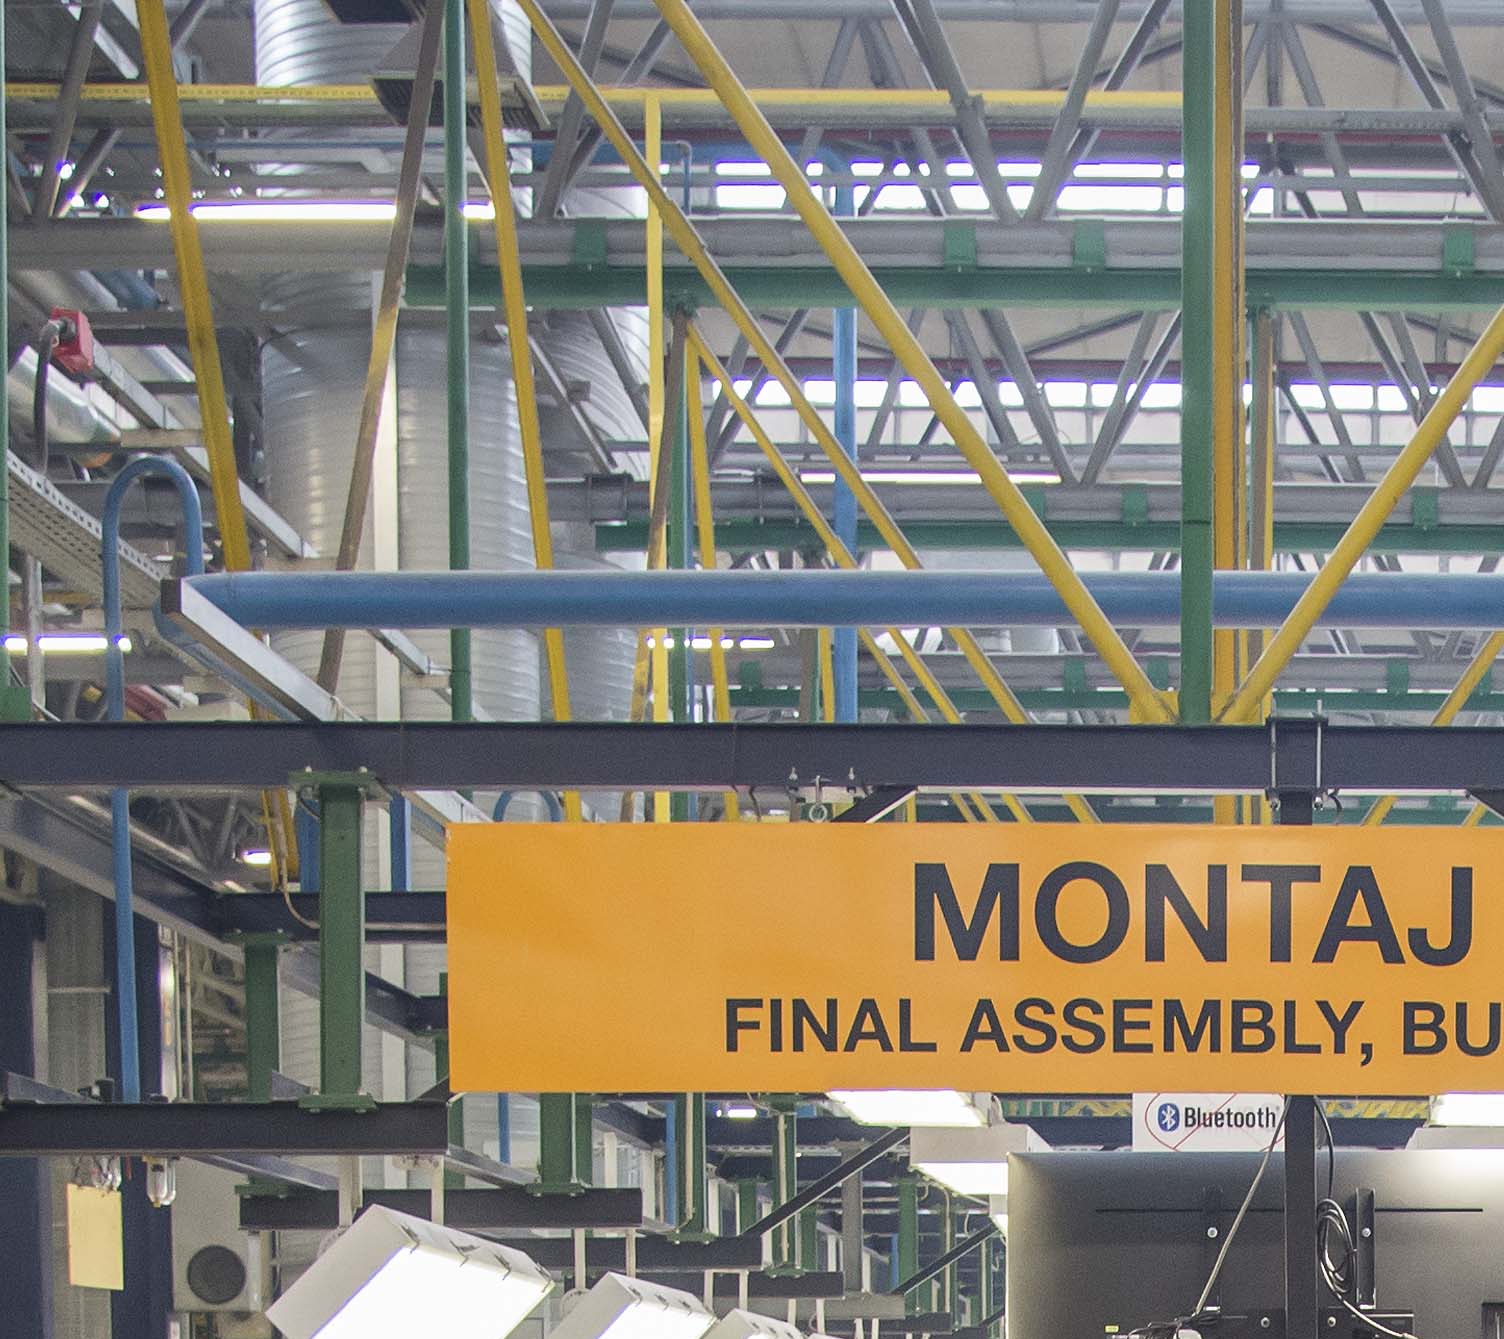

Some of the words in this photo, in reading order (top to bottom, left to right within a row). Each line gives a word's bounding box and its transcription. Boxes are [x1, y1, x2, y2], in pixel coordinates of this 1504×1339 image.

[914, 860, 1474, 967] MONTAJ
[725, 998, 937, 1053] FINAL
[959, 997, 1373, 1067] ASSEMBLY,
[1184, 1107, 1276, 1128] Bluetooth
